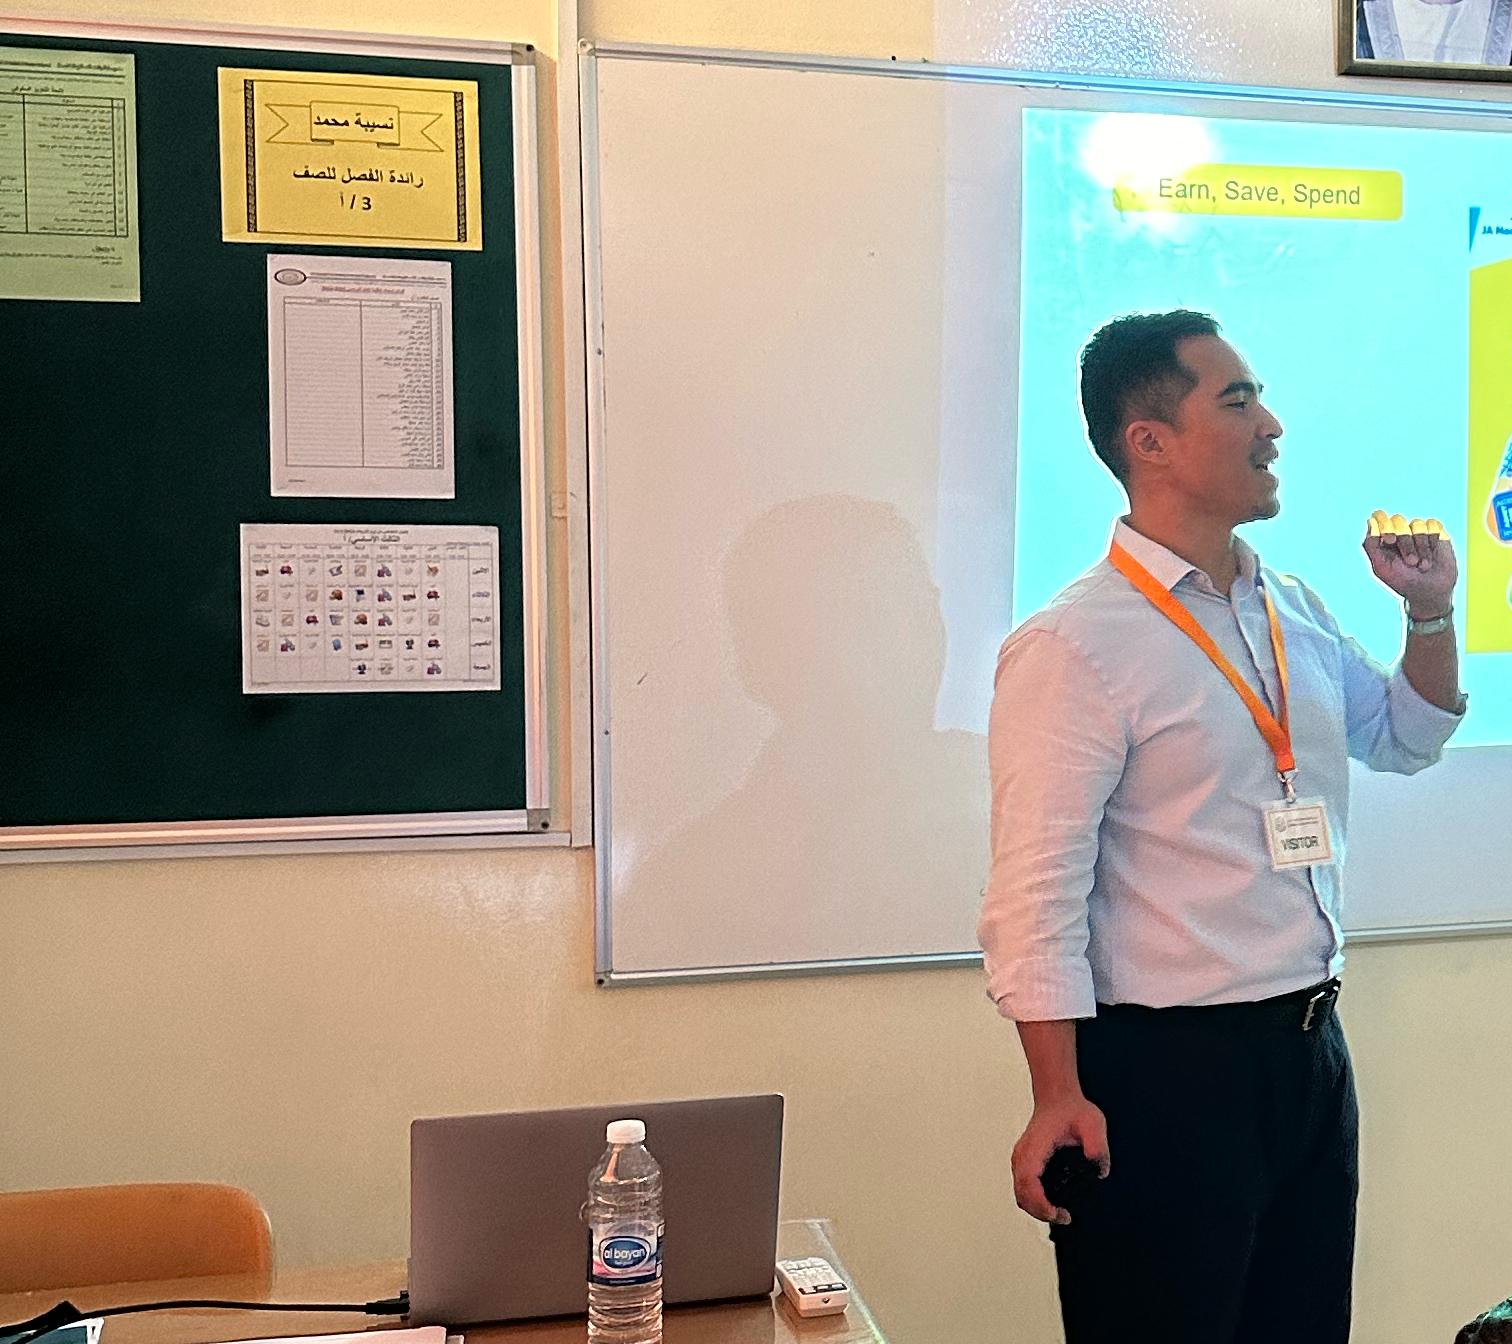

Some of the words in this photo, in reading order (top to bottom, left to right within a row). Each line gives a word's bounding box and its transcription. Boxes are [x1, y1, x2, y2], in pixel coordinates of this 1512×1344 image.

[313, 114, 350, 127] محمد
[293, 165, 336, 182] للصف
[341, 168, 384, 184] الفصل
[1158, 177, 1217, 203] Earn,
[1225, 180, 1285, 206] Save,
[1293, 183, 1361, 209] Spend
[361, 197, 372, 211] 3
[1481, 226, 1493, 235] JA
[614, 1248, 645, 1261] bayan
